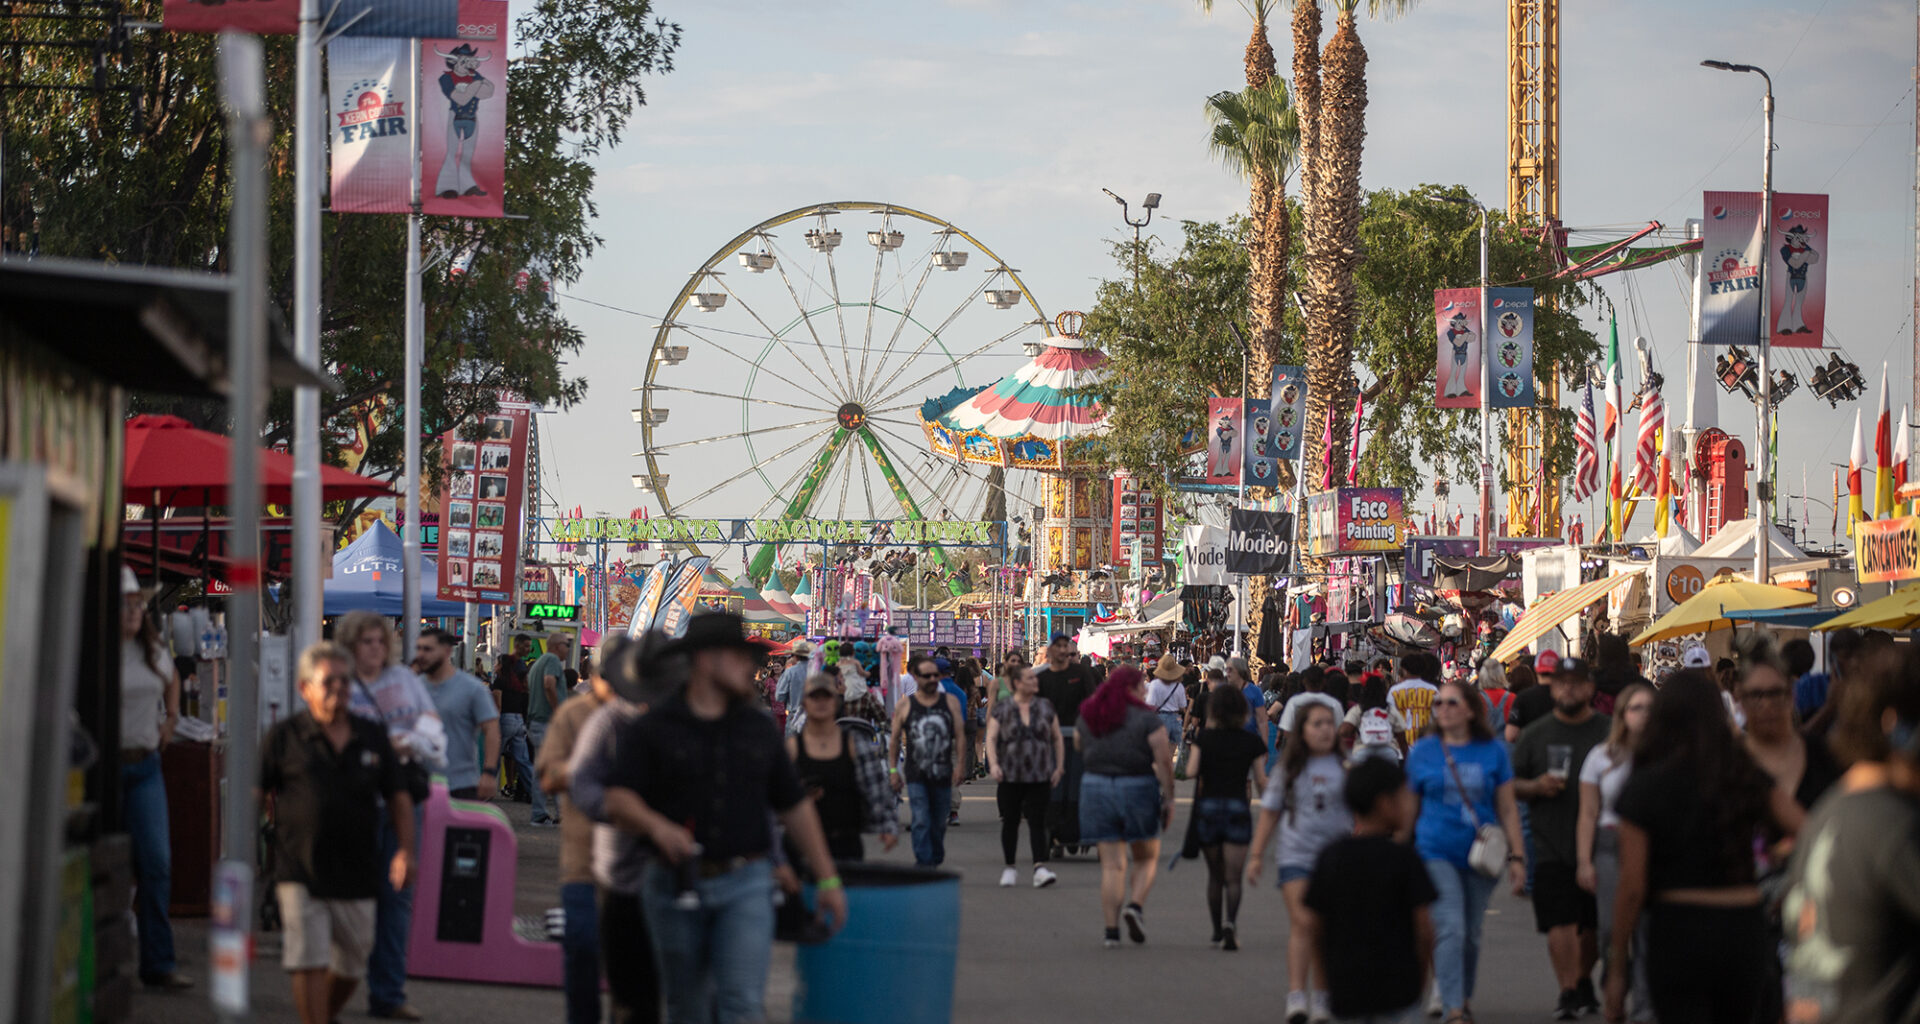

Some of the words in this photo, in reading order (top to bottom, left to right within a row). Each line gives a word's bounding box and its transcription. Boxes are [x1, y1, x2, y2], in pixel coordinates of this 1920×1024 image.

[456, 23, 497, 36] pepsi
[344, 109, 367, 124] KERN
[368, 104, 399, 119] COUNTY
[340, 117, 407, 144] FAIR
[1792, 209, 1821, 219] pepsi
[1712, 270, 1728, 280] KERN
[1729, 267, 1753, 279] COUNTY
[1709, 276, 1760, 295] FAIR
[1453, 300, 1477, 309] pepsi
[1504, 299, 1528, 309] pepsi
[1351, 496, 1389, 521] Face
[550, 517, 720, 540] AMUSEMENTS
[755, 519, 867, 541] MAGICAL
[894, 520, 993, 542] MIDWAY
[1346, 521, 1396, 544] Painting
[1229, 529, 1289, 556] Modelo
[1861, 527, 1918, 575] CARICATURES
[1185, 545, 1229, 566] Model
[343, 561, 404, 574] ULTR
[1670, 574, 1702, 595] $10
[529, 604, 575, 618] ATM
